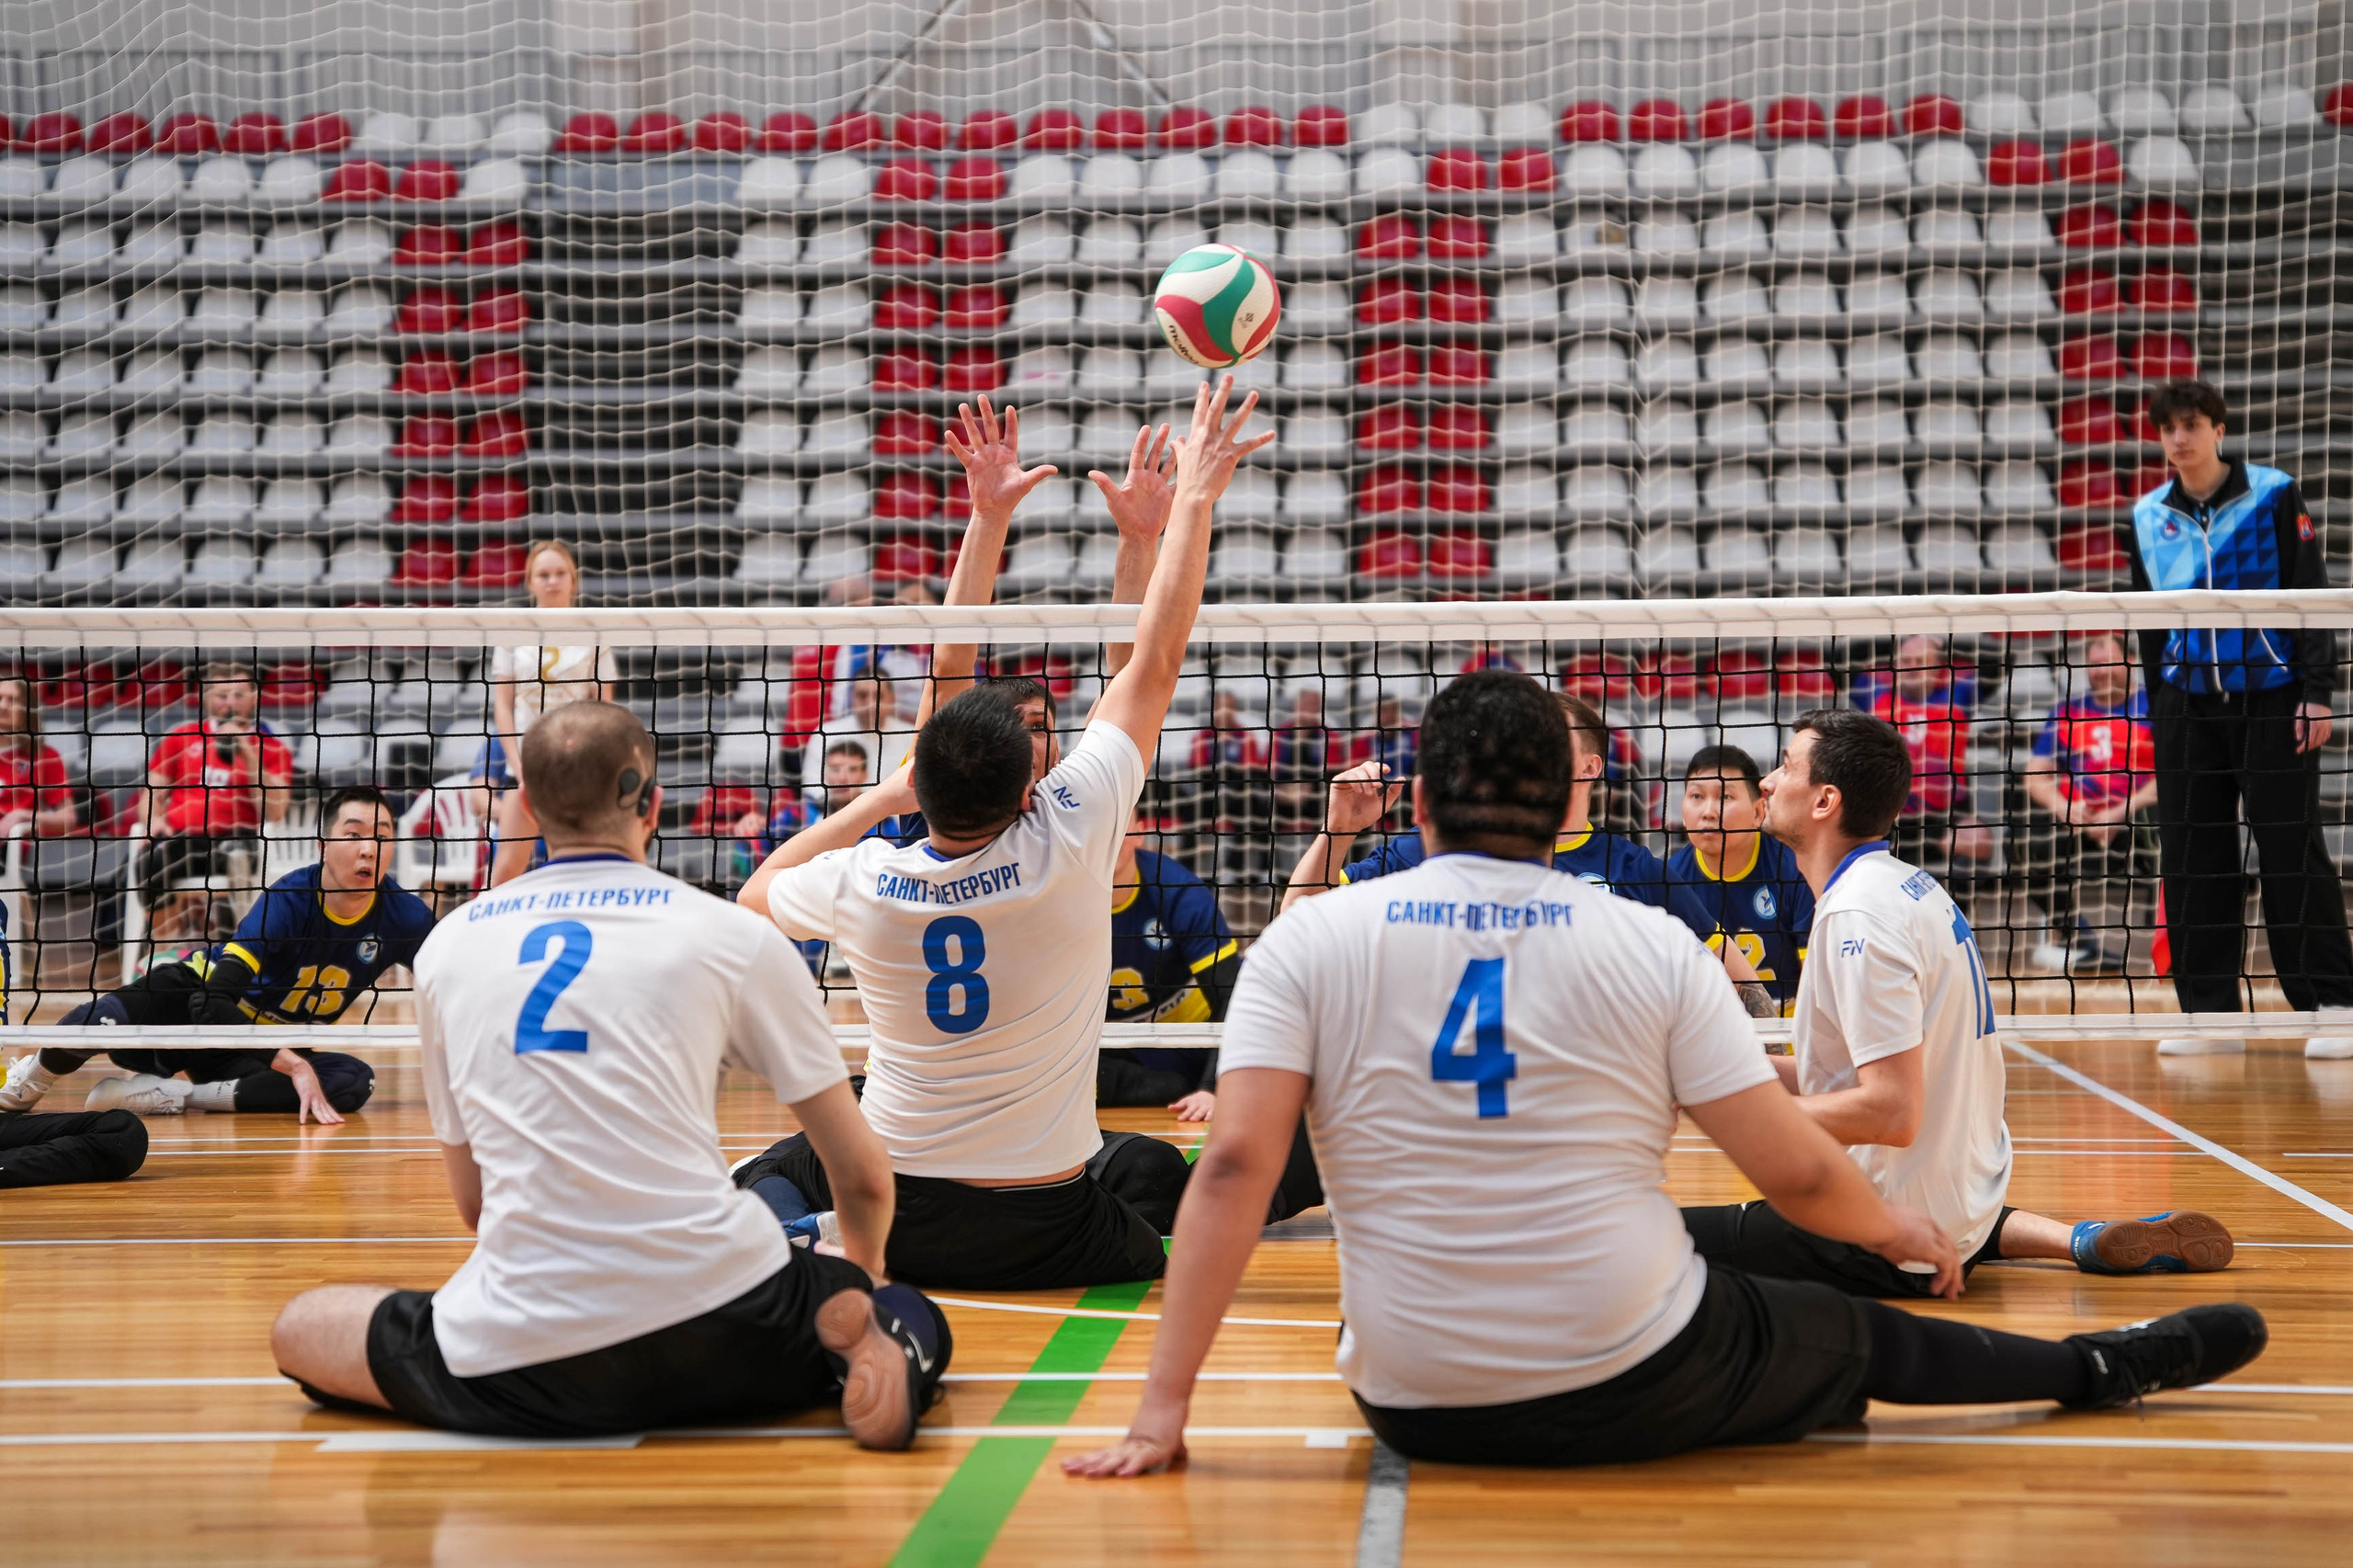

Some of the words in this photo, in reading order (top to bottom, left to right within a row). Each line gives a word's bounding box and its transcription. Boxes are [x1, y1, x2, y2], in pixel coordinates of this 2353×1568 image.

[469, 887, 674, 922] САНКТ-ПЕТЕРБУРГ
[877, 862, 1021, 905] САНКТ-ПЕТЕРБУРГ
[1386, 899, 1574, 932] САНКТ-ПЕТЕРБУРГ
[279, 964, 350, 1016] 13
[515, 919, 593, 1055] 2
[922, 915, 990, 1035] 8
[1431, 957, 1518, 1120] 4
